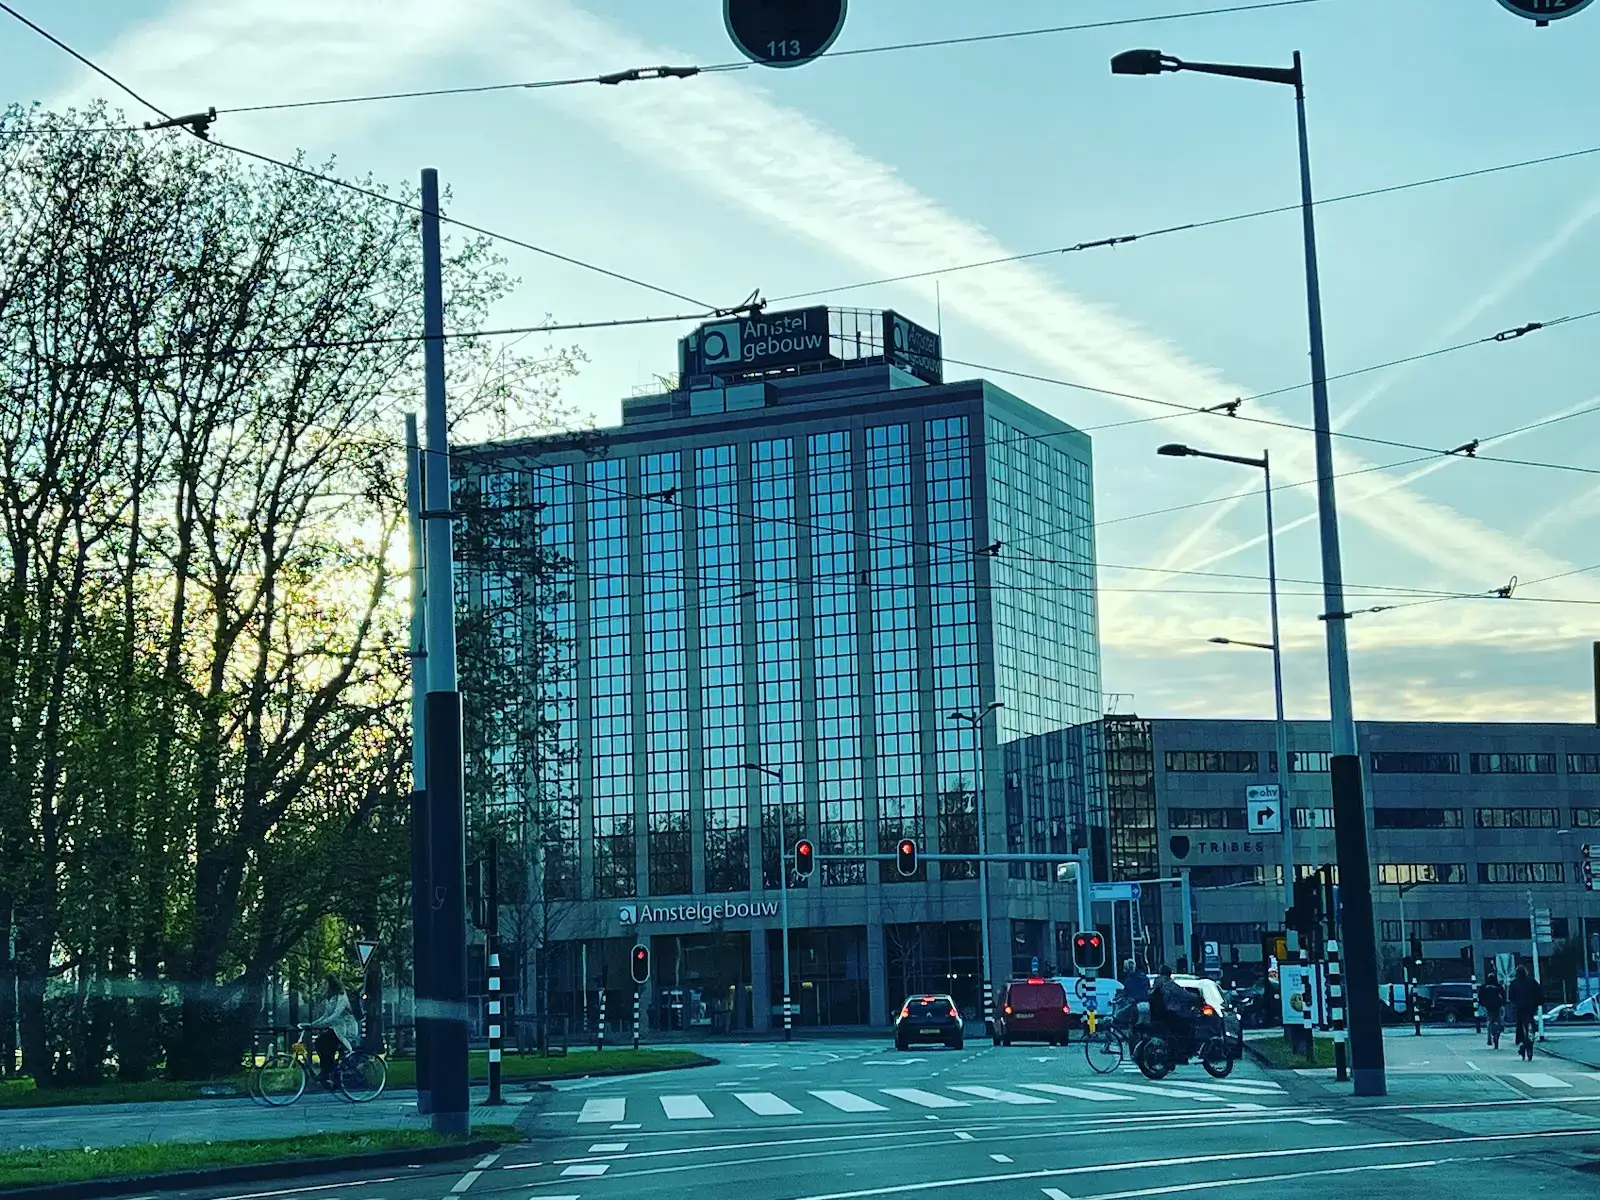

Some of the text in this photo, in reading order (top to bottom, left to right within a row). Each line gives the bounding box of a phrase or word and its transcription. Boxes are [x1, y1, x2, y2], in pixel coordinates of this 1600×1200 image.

[766, 39, 801, 57] 113
[743, 312, 807, 339] Amstel
[743, 334, 823, 362] gebouw
[1198, 841, 1264, 853] TRIBES
[639, 900, 779, 925] Amstelgebouw
